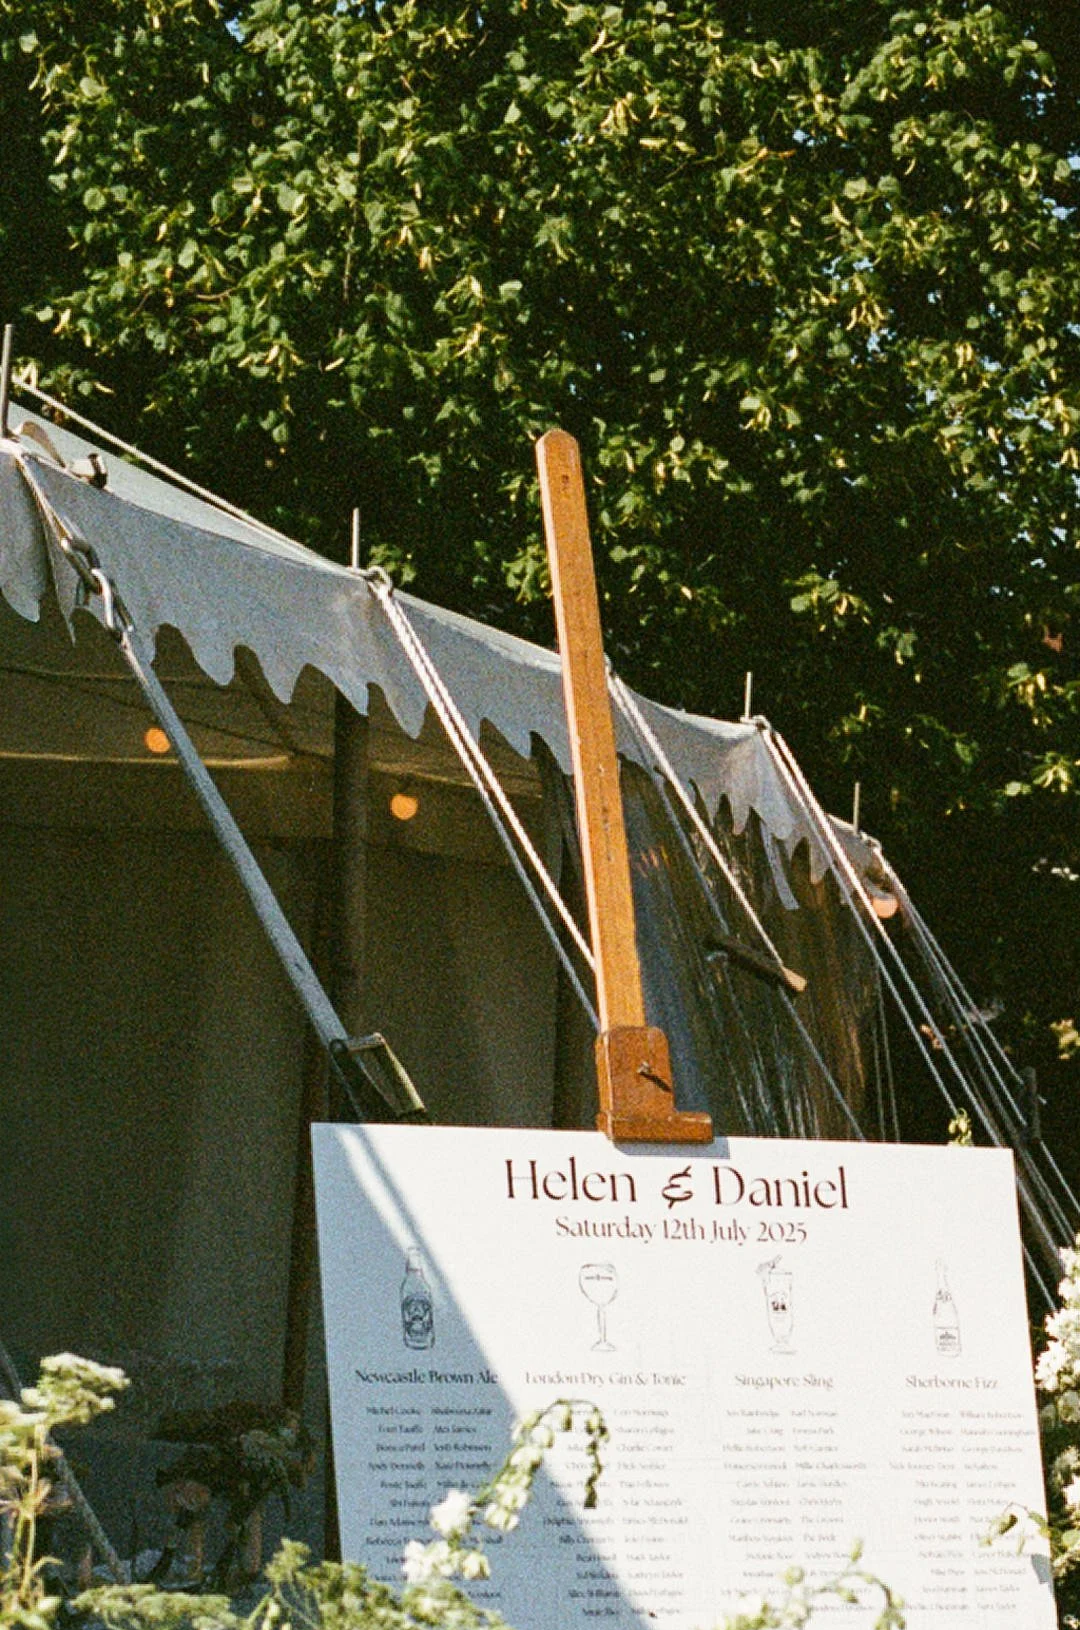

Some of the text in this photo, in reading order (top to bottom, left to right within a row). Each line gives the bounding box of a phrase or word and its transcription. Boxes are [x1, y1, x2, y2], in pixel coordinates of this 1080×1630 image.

[505, 1157, 850, 1209] Helen & Daniel
[555, 1216, 809, 1246] Saturday 12th July 2025
[355, 1368, 499, 1385] Newcastle Brown Ale
[525, 1370, 687, 1388] London Dry Gin & Tonic
[734, 1373, 834, 1391] Singapore Sling
[905, 1374, 971, 1389] Sherborne
